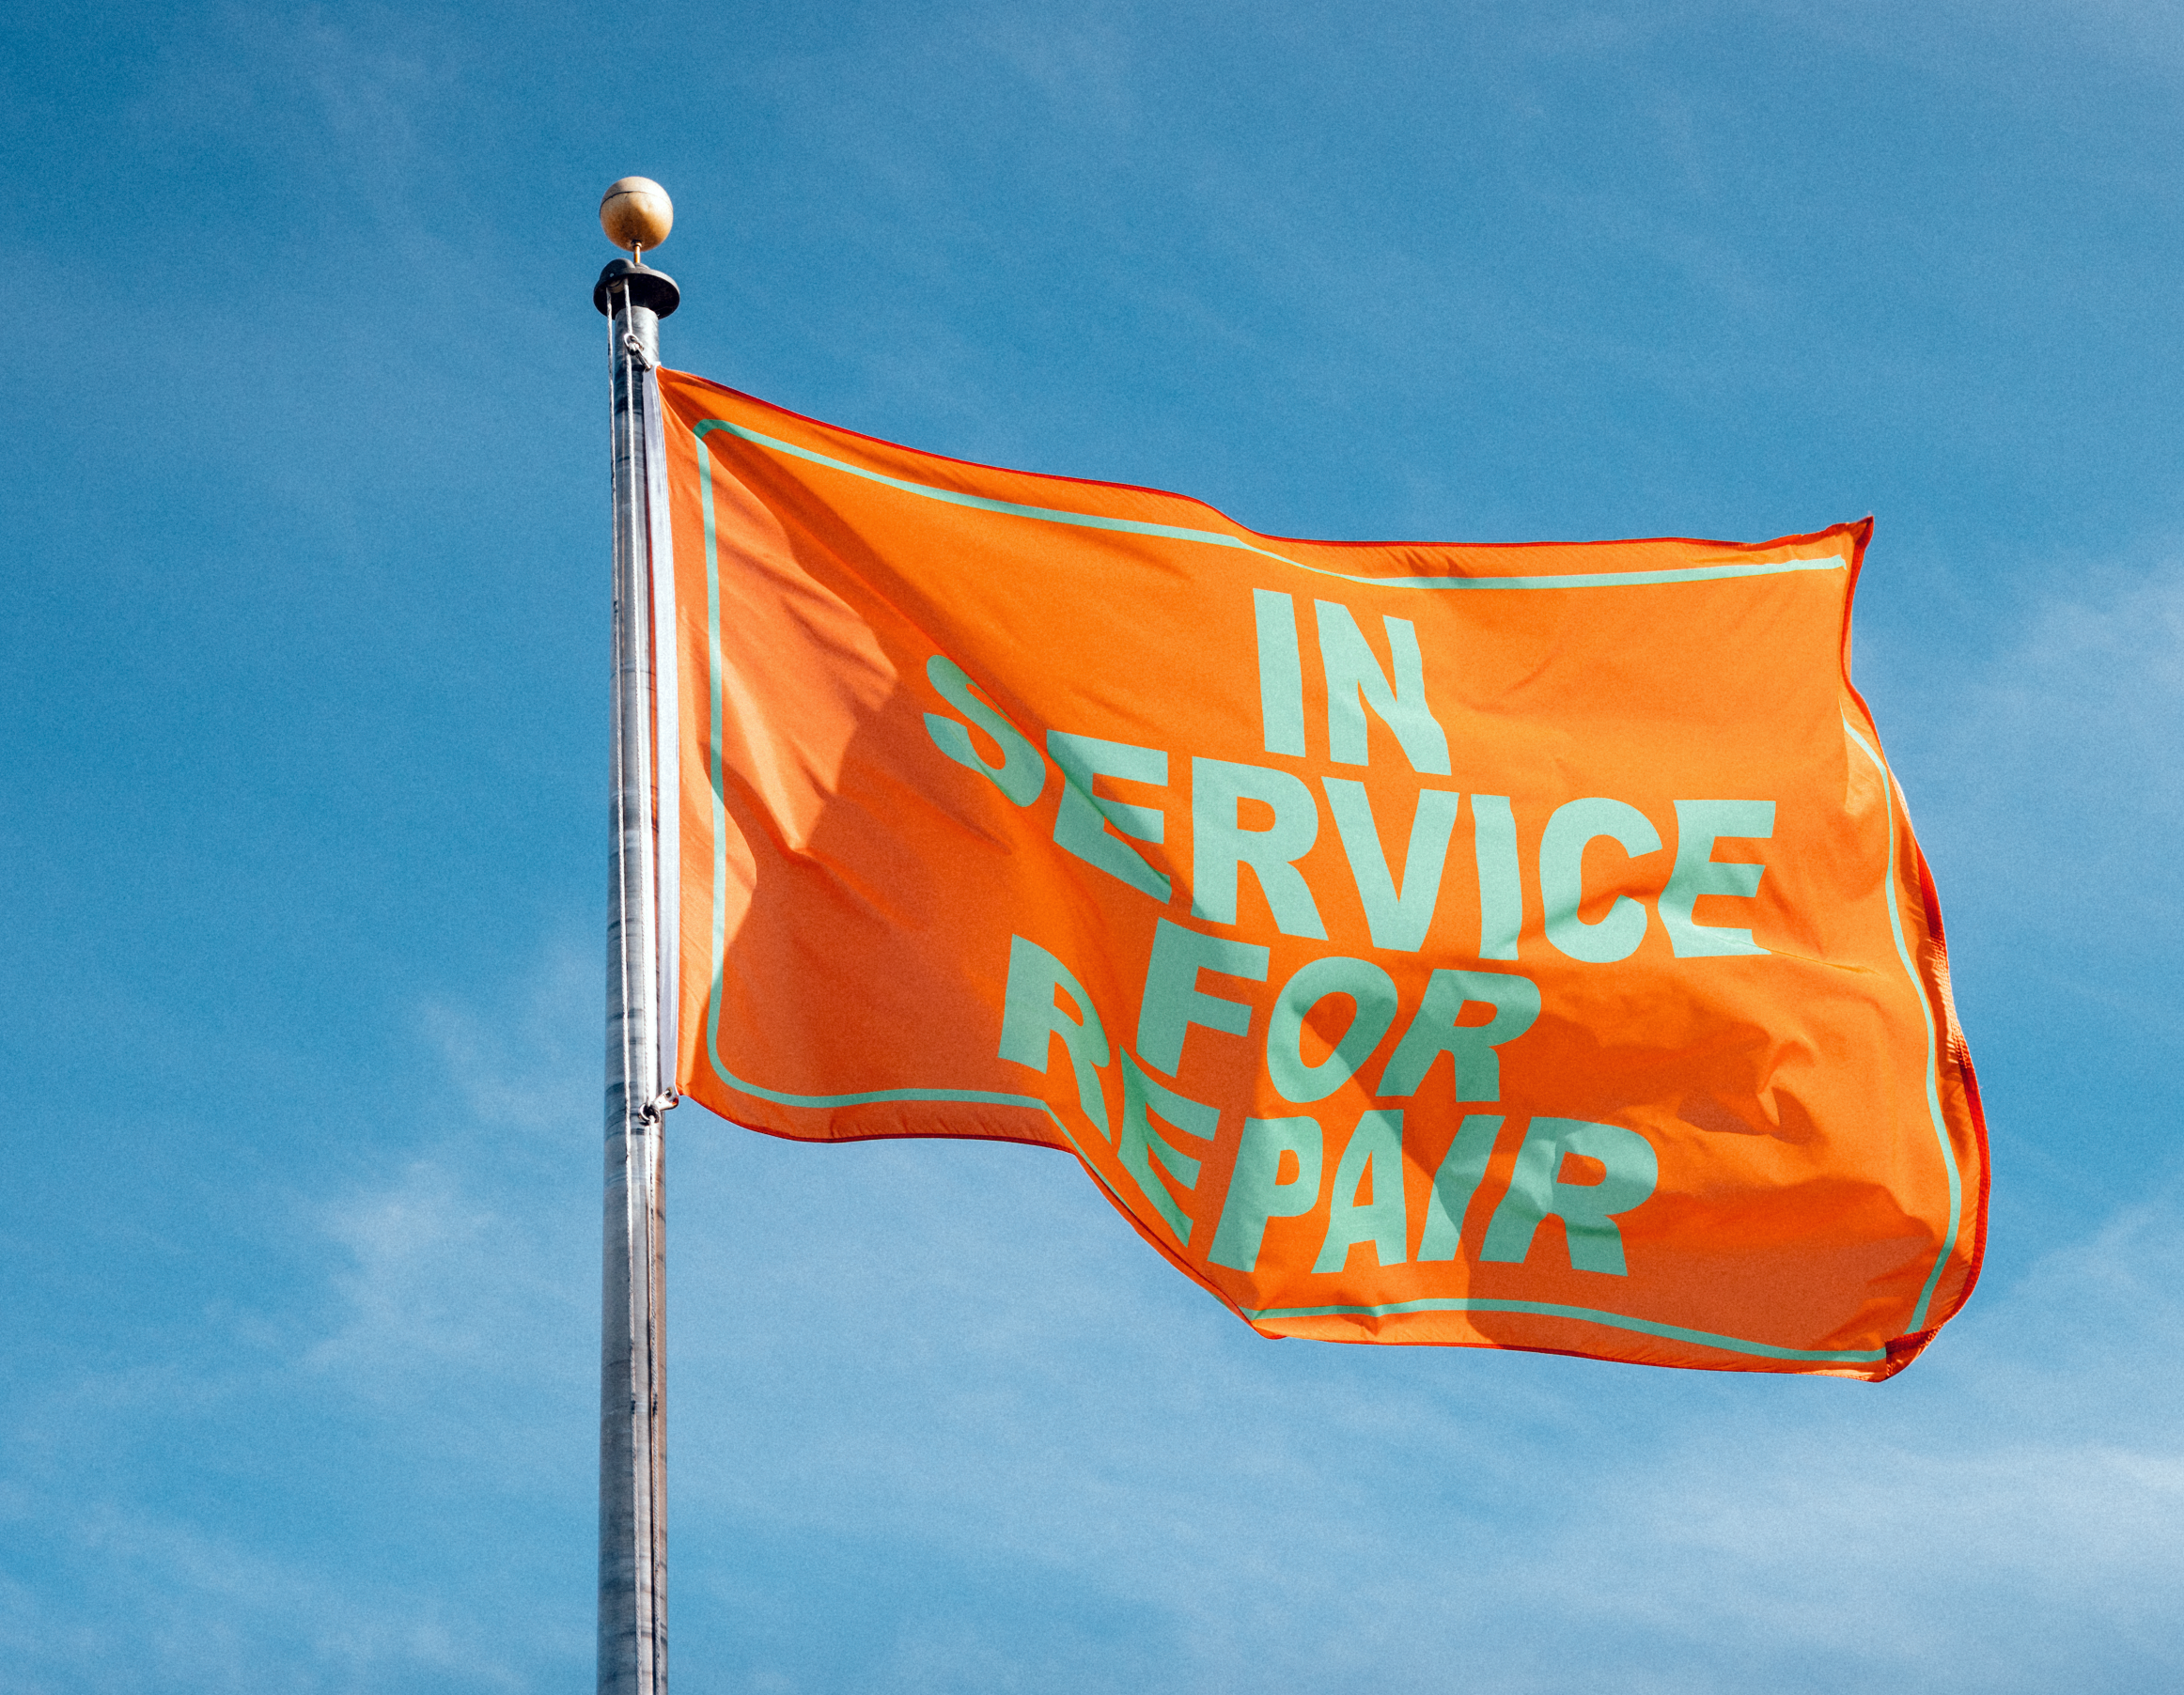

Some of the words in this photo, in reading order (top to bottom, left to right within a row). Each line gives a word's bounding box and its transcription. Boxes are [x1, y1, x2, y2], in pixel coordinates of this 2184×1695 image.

[1253, 588, 1451, 776] IN
[924, 655, 1776, 964] SERVICE
[998, 935, 1659, 1277] REPAIR
[1135, 917, 1541, 1104] FOR
